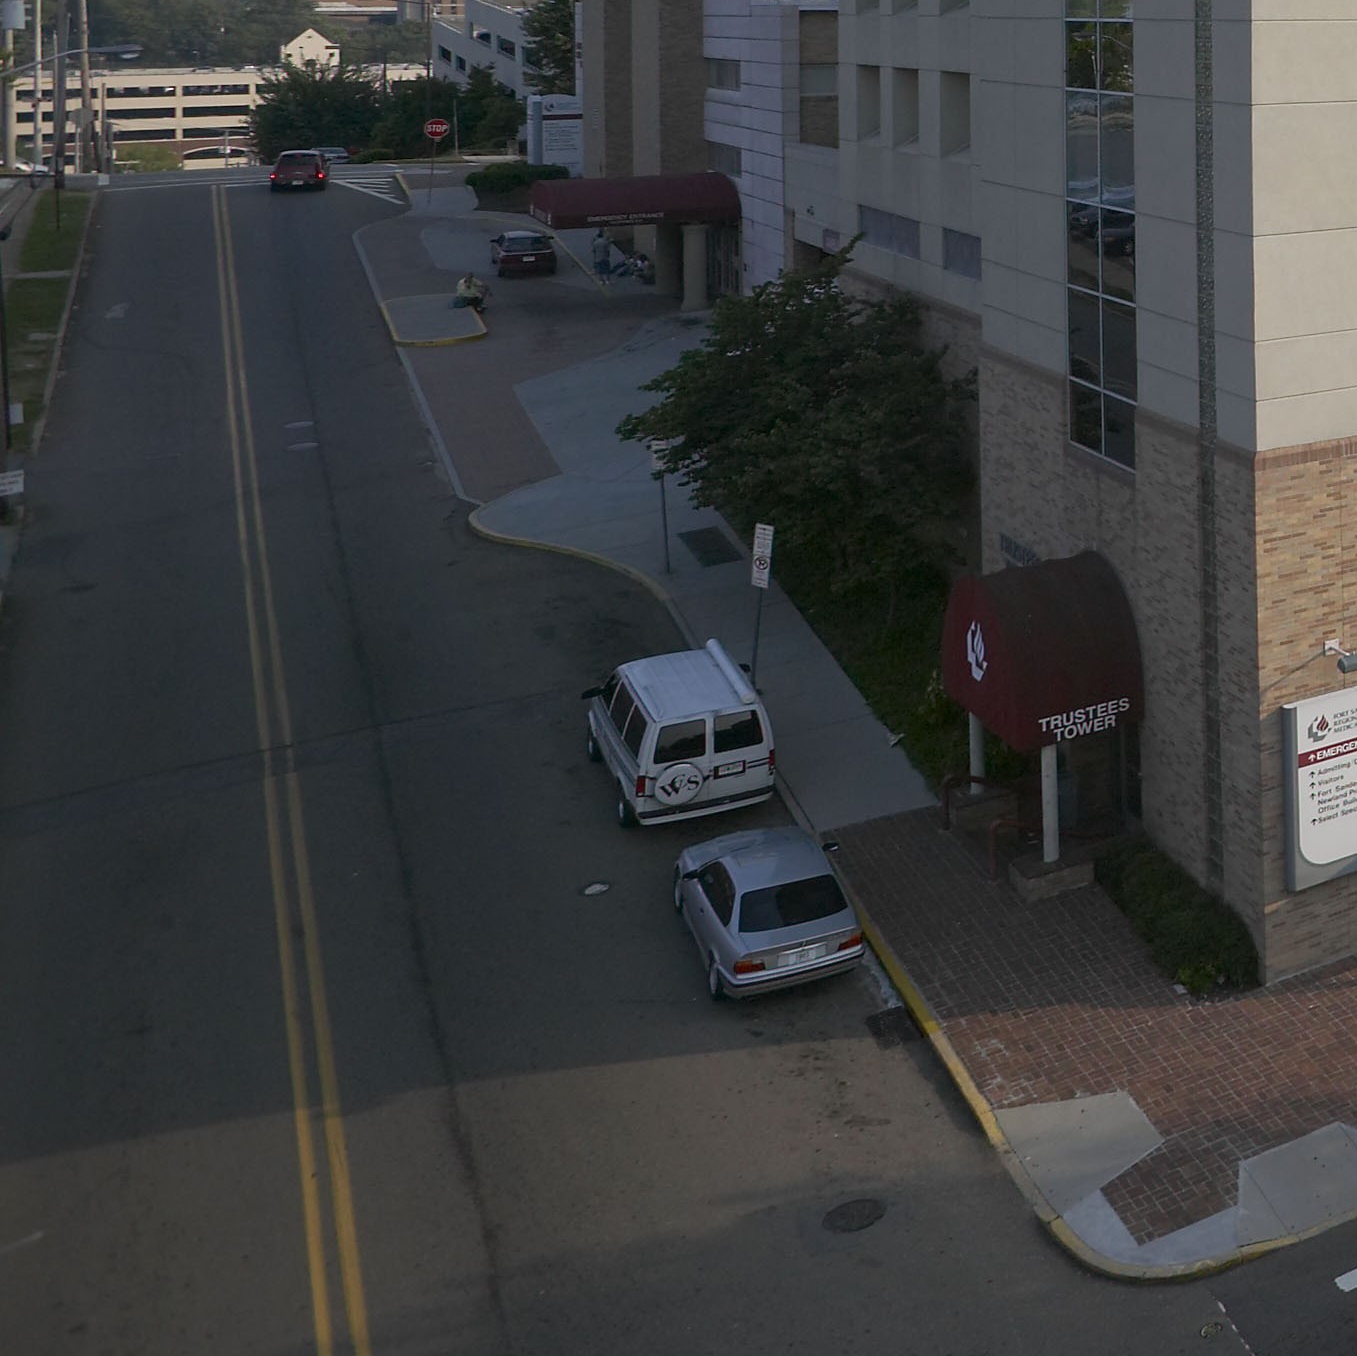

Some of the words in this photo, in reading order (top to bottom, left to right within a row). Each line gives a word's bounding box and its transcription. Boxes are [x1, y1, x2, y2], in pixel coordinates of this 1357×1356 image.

[427, 124, 448, 133] STOP
[1038, 697, 1130, 732] TRUSTEES
[1333, 710, 1349, 719] FORT
[1053, 715, 1116, 742] TOWER
[1318, 774, 1344, 786] Visitors
[1317, 788, 1332, 797] Fort
[1318, 791, 1348, 805] Newland
[1318, 803, 1340, 814] Office
[1318, 812, 1339, 824] Select
